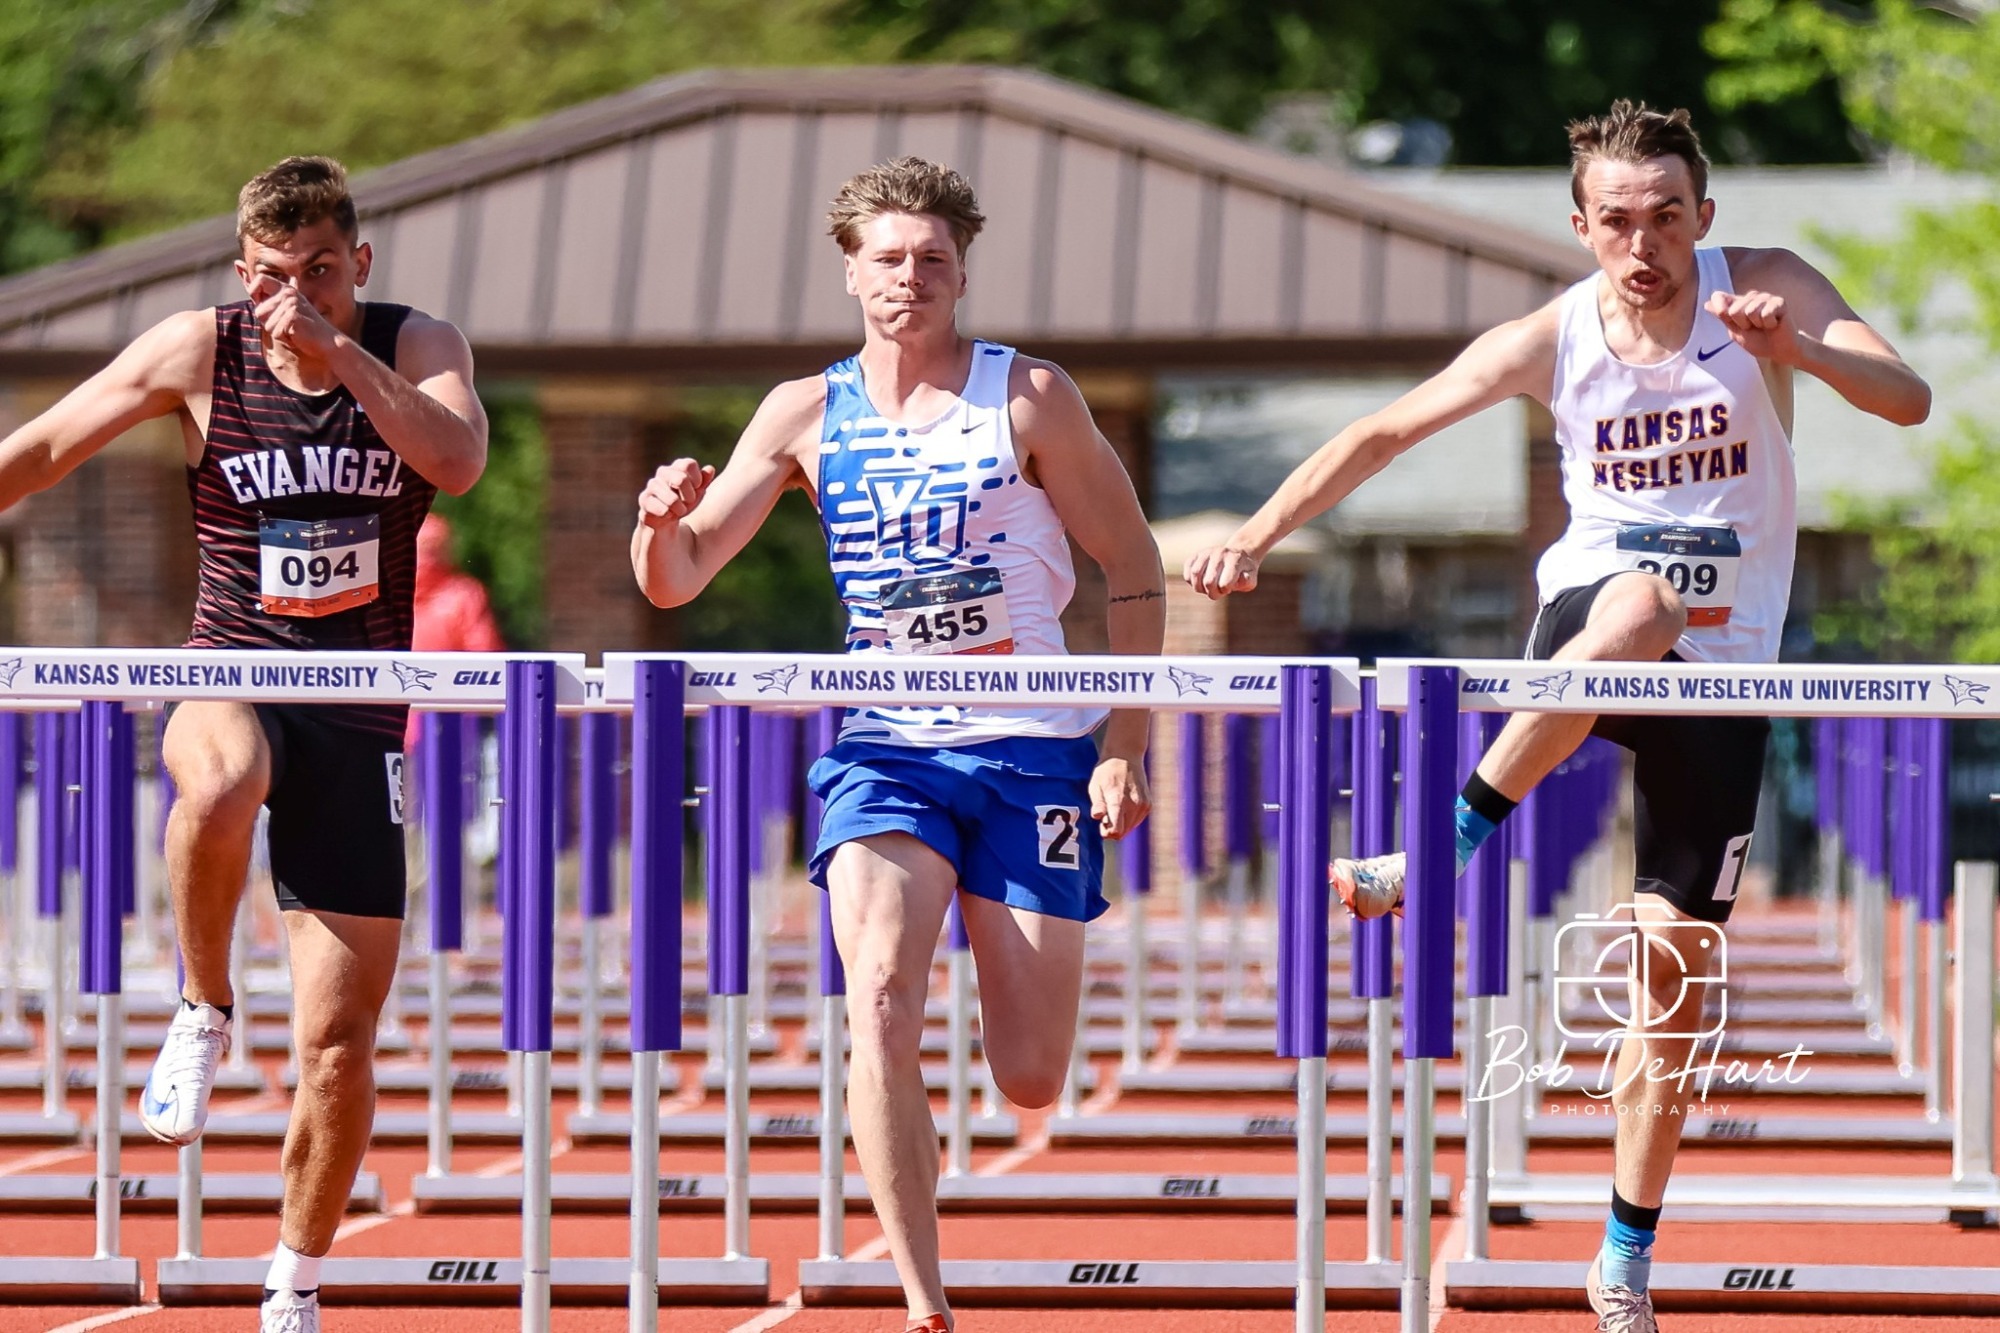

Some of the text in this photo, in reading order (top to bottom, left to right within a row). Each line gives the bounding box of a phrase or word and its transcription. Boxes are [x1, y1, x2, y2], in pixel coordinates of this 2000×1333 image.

[1595, 402, 1730, 453] KANSAS
[219, 445, 403, 504] EVANGEL
[1592, 441, 1749, 493] WESLEYAN
[280, 550, 360, 588] 094
[907, 604, 988, 643] 455
[34, 663, 379, 688] KANSAS WESLEYAN UNIVERSITY
[452, 670, 502, 686] GILL
[688, 671, 738, 687] GILL
[810, 669, 1156, 692] KANSAS WESLEYAN UNIVERSITY
[1229, 675, 1279, 690] GILL
[1461, 678, 1511, 694] GILL
[1584, 676, 1932, 701] KANSAS WESLEYAN UNIVERSITY
[1043, 808, 1075, 864] 2
[1731, 837, 1751, 896] 1
[1161, 1178, 1221, 1198] GILL
[427, 1260, 499, 1284] GILL
[1068, 1262, 1140, 1285] GILL
[1723, 1268, 1796, 1291] GILL
